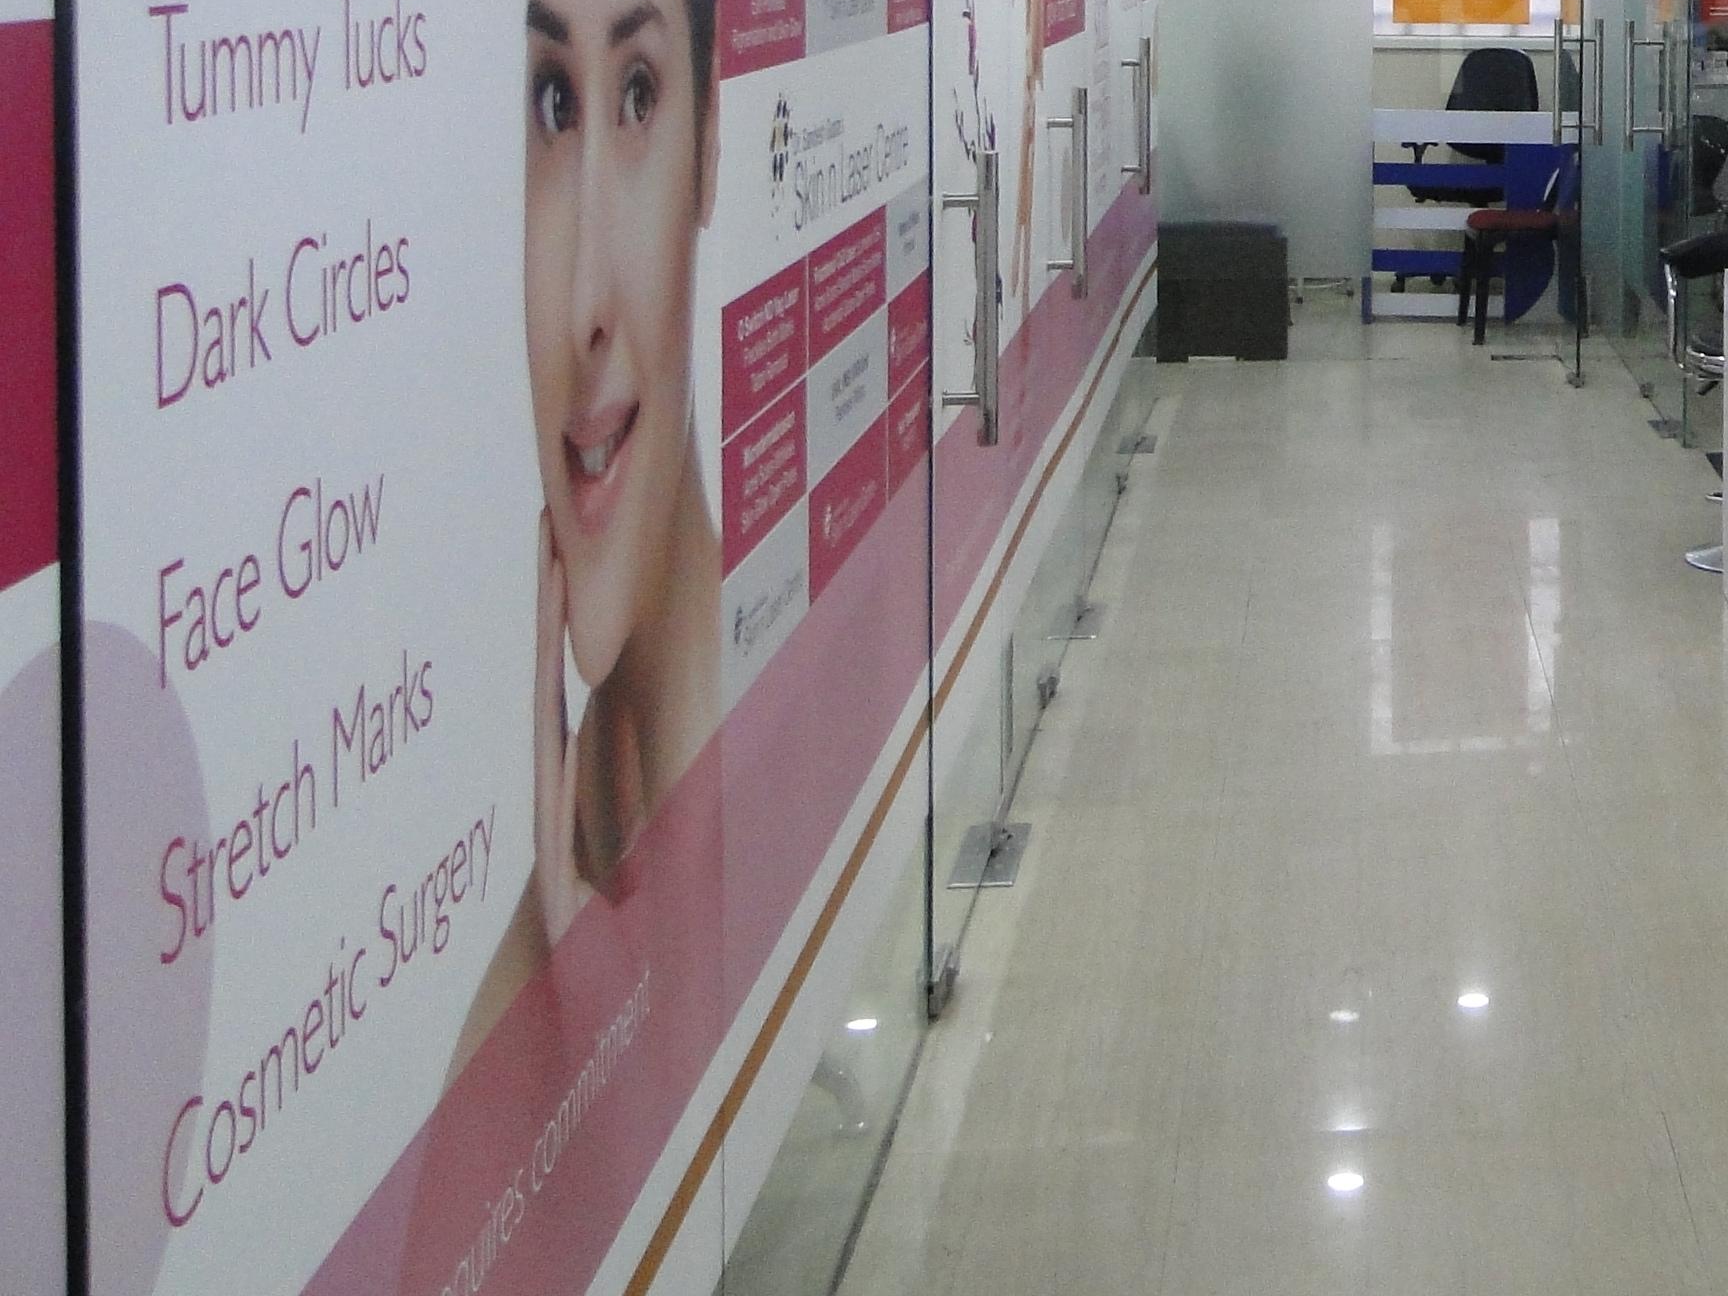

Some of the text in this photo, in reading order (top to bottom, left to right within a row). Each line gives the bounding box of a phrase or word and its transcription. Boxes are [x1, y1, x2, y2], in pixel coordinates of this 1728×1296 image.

[148, 3, 321, 134] Tummy
[156, 218, 410, 410] Dark Circles
[158, 473, 385, 690] Face Glow
[160, 649, 434, 965] Stretch Marks
[162, 804, 496, 1228] Cosmetic Surgery
